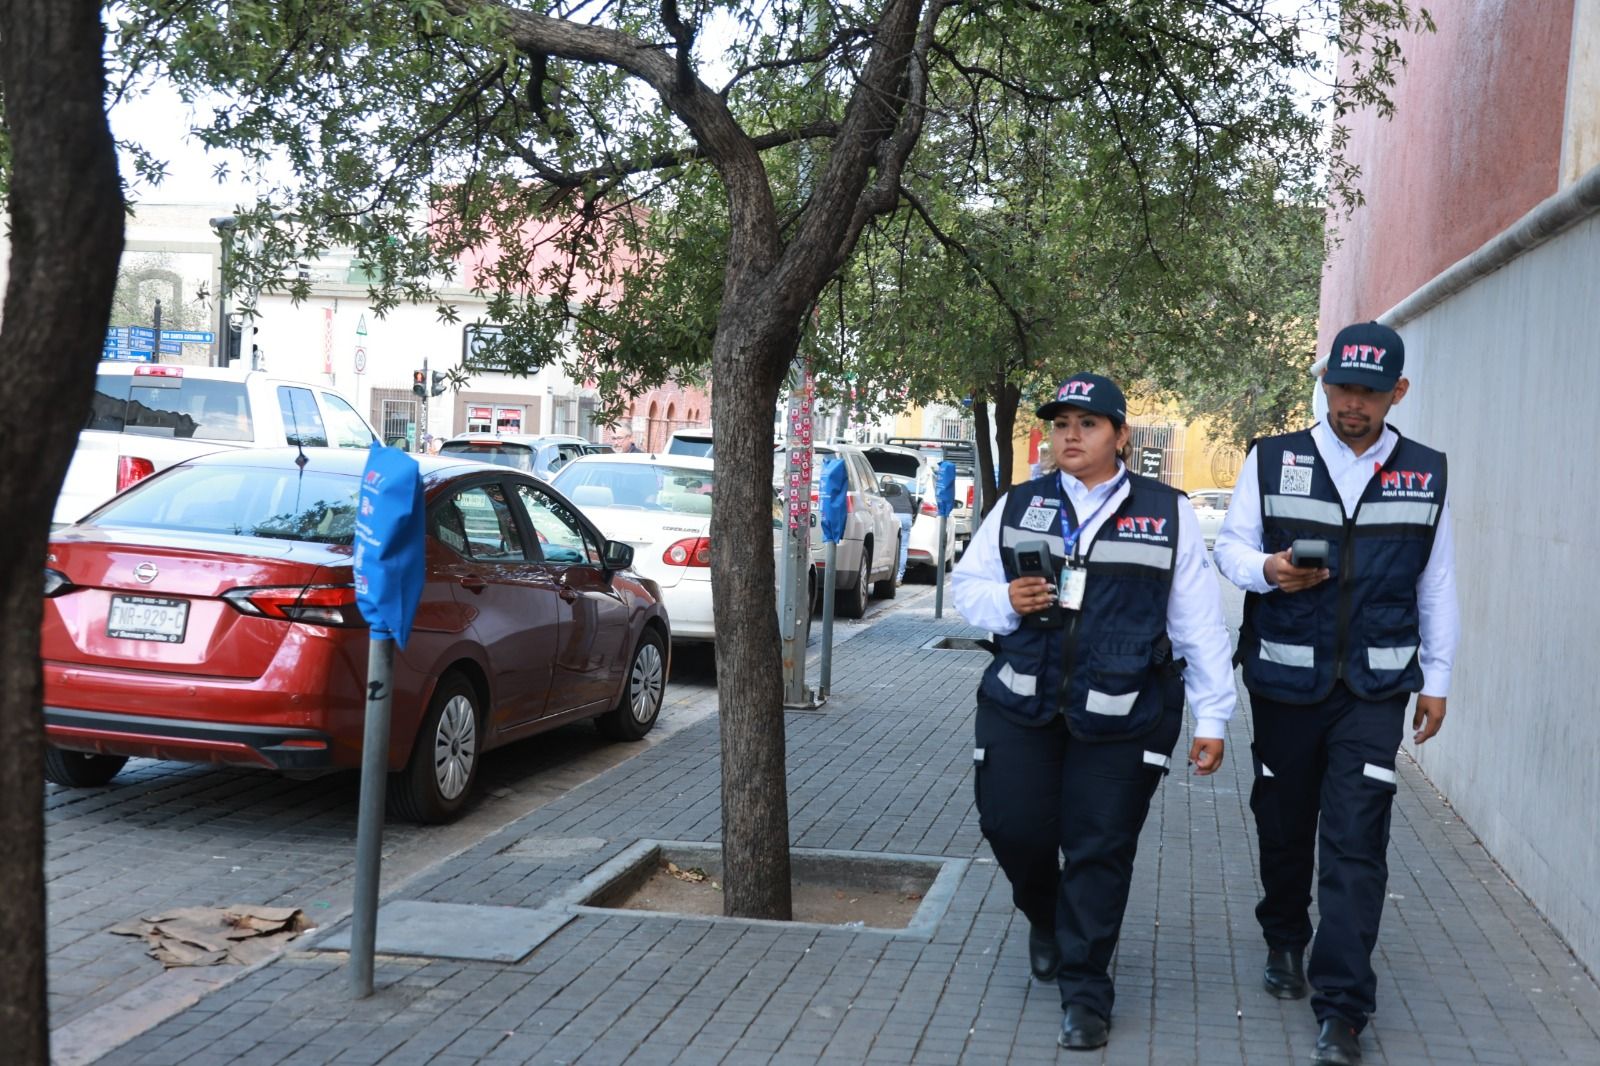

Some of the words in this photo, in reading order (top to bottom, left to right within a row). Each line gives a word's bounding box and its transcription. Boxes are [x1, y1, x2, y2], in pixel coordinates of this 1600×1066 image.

[1342, 344, 1387, 364] MTY
[1058, 381, 1095, 402] MTY
[1381, 470, 1433, 491] MTY
[1382, 489, 1398, 497] AQUÍ
[1116, 516, 1167, 534] MTY
